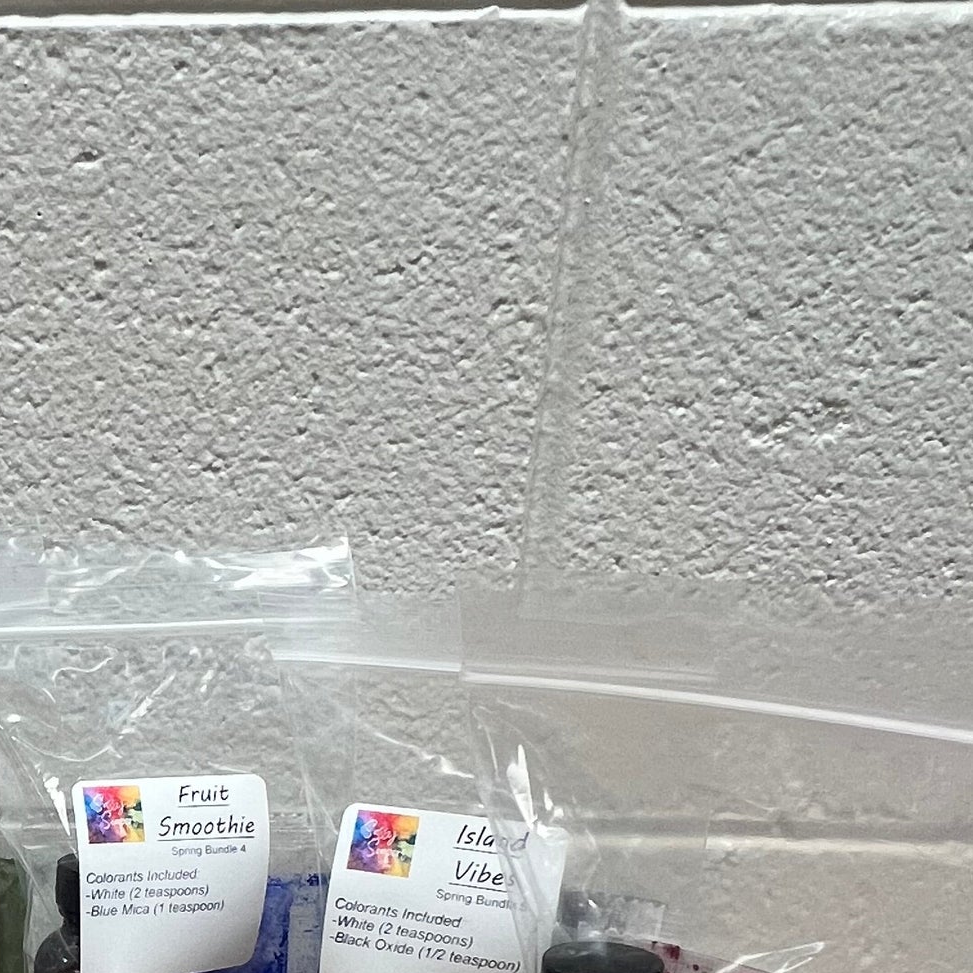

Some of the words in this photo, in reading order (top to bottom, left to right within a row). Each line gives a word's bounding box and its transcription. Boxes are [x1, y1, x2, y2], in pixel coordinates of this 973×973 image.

[178, 784, 230, 803] Fruit
[158, 815, 255, 837] Smoothie
[456, 824, 529, 852] Island
[171, 846, 202, 857] Spring
[205, 844, 237, 855] Bundle
[240, 844, 246, 852] 4
[86, 871, 144, 885] Colorants
[455, 860, 515, 886] Vibes
[85, 888, 125, 901] -White
[129, 887, 141, 900] (2
[144, 884, 209, 899] teaspoons)
[436, 888, 473, 905] Spring
[85, 905, 118, 917] -Blue
[122, 903, 149, 916] Mica
[153, 903, 164, 917] (1
[168, 899, 224, 914] teaspoon)
[334, 897, 404, 918] Colorants
[332, 914, 374, 932] -White
[378, 920, 393, 936] (2
[395, 924, 474, 949] teaspoons)
[329, 932, 371, 948] -Black
[374, 938, 414, 955] Oxide
[418, 947, 447, 961] (1/2
